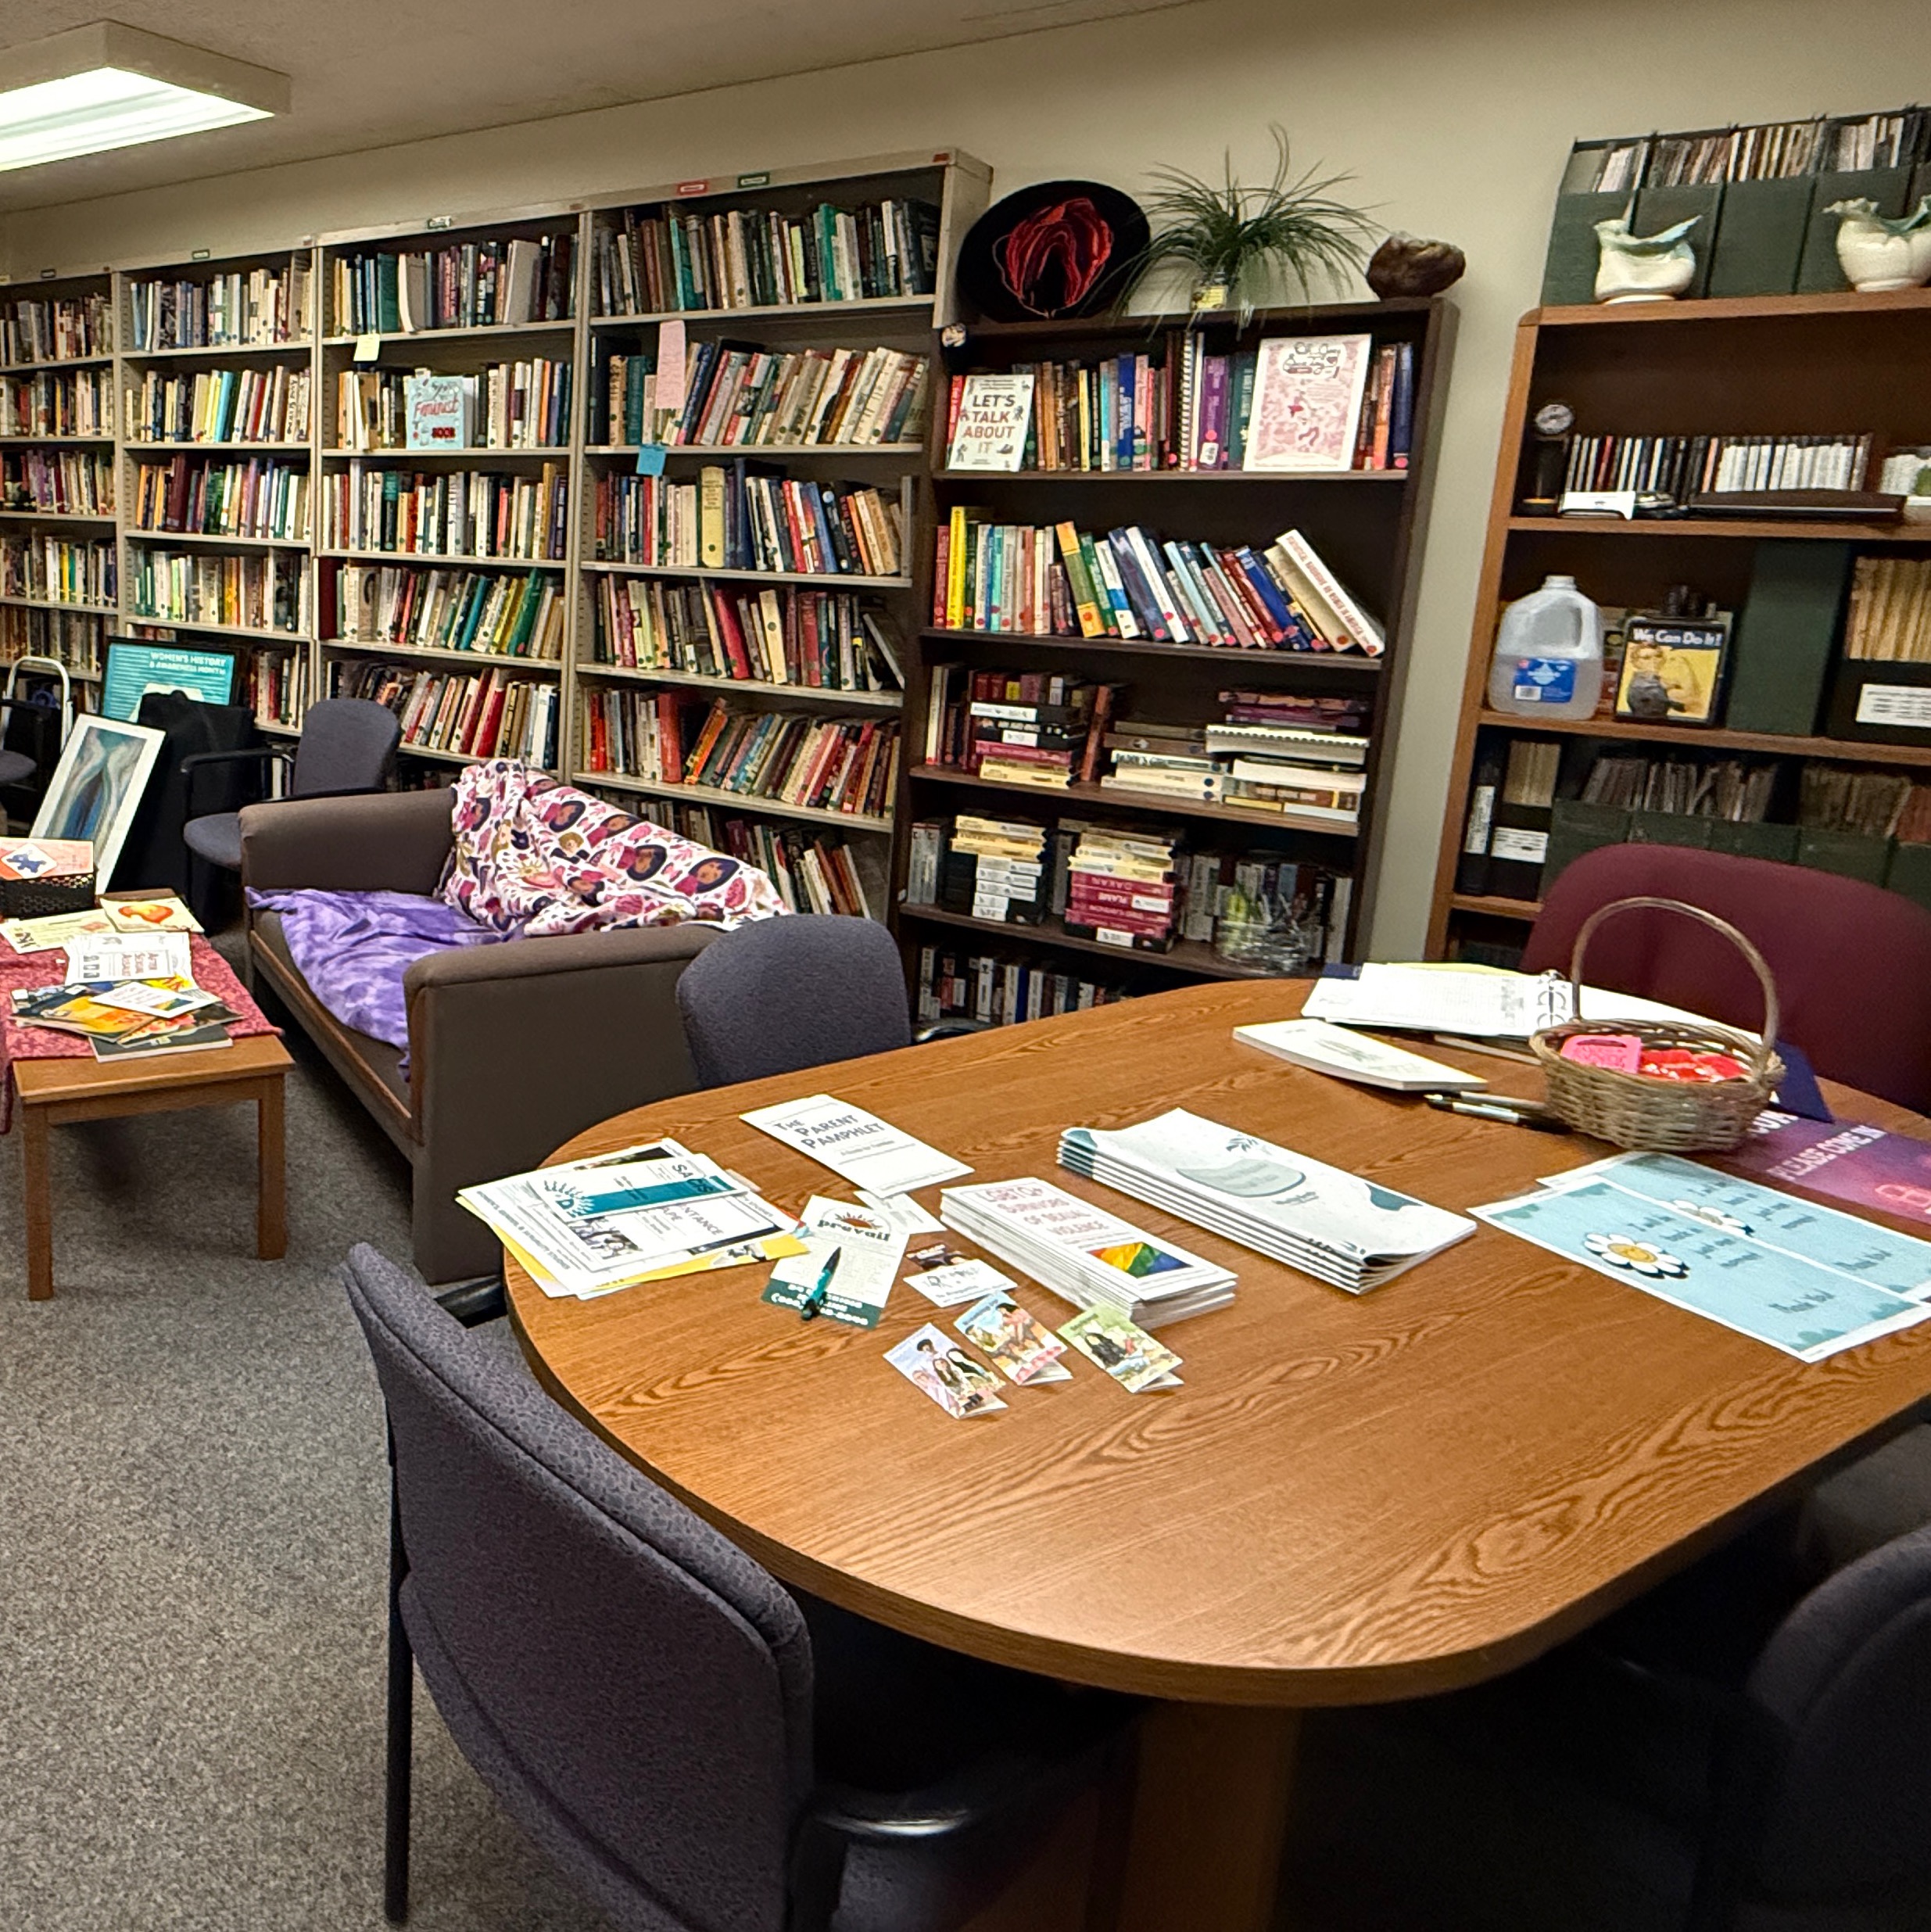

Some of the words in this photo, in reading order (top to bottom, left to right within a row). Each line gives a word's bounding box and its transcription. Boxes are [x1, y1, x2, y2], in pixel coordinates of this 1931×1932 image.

[973, 394, 1016, 407] LET'S
[973, 410, 1011, 423] TALK
[962, 426, 1016, 439] ABOUT
[977, 442, 994, 454] IT
[1632, 628, 1655, 643] We
[1655, 629, 1682, 643] Can
[1682, 631, 1704, 645] Do
[149, 651, 188, 663] WOMEN'S
[190, 655, 227, 668] HISTORY
[773, 1119, 806, 1132] THE
[794, 1114, 860, 1137] PARENT
[800, 1122, 886, 1149] PAMPHLET
[1766, 1147, 1837, 1182] PLEASE
[1816, 1131, 1874, 1155] COME
[1860, 1124, 1888, 1140] IN
[977, 1185, 1044, 1203] LGBTQ+
[997, 1198, 1070, 1213] SURVIVORS
[1023, 1213, 1046, 1225] OF
[817, 1219, 891, 1242] prevail
[1047, 1220, 1110, 1236] VIOLENCE
